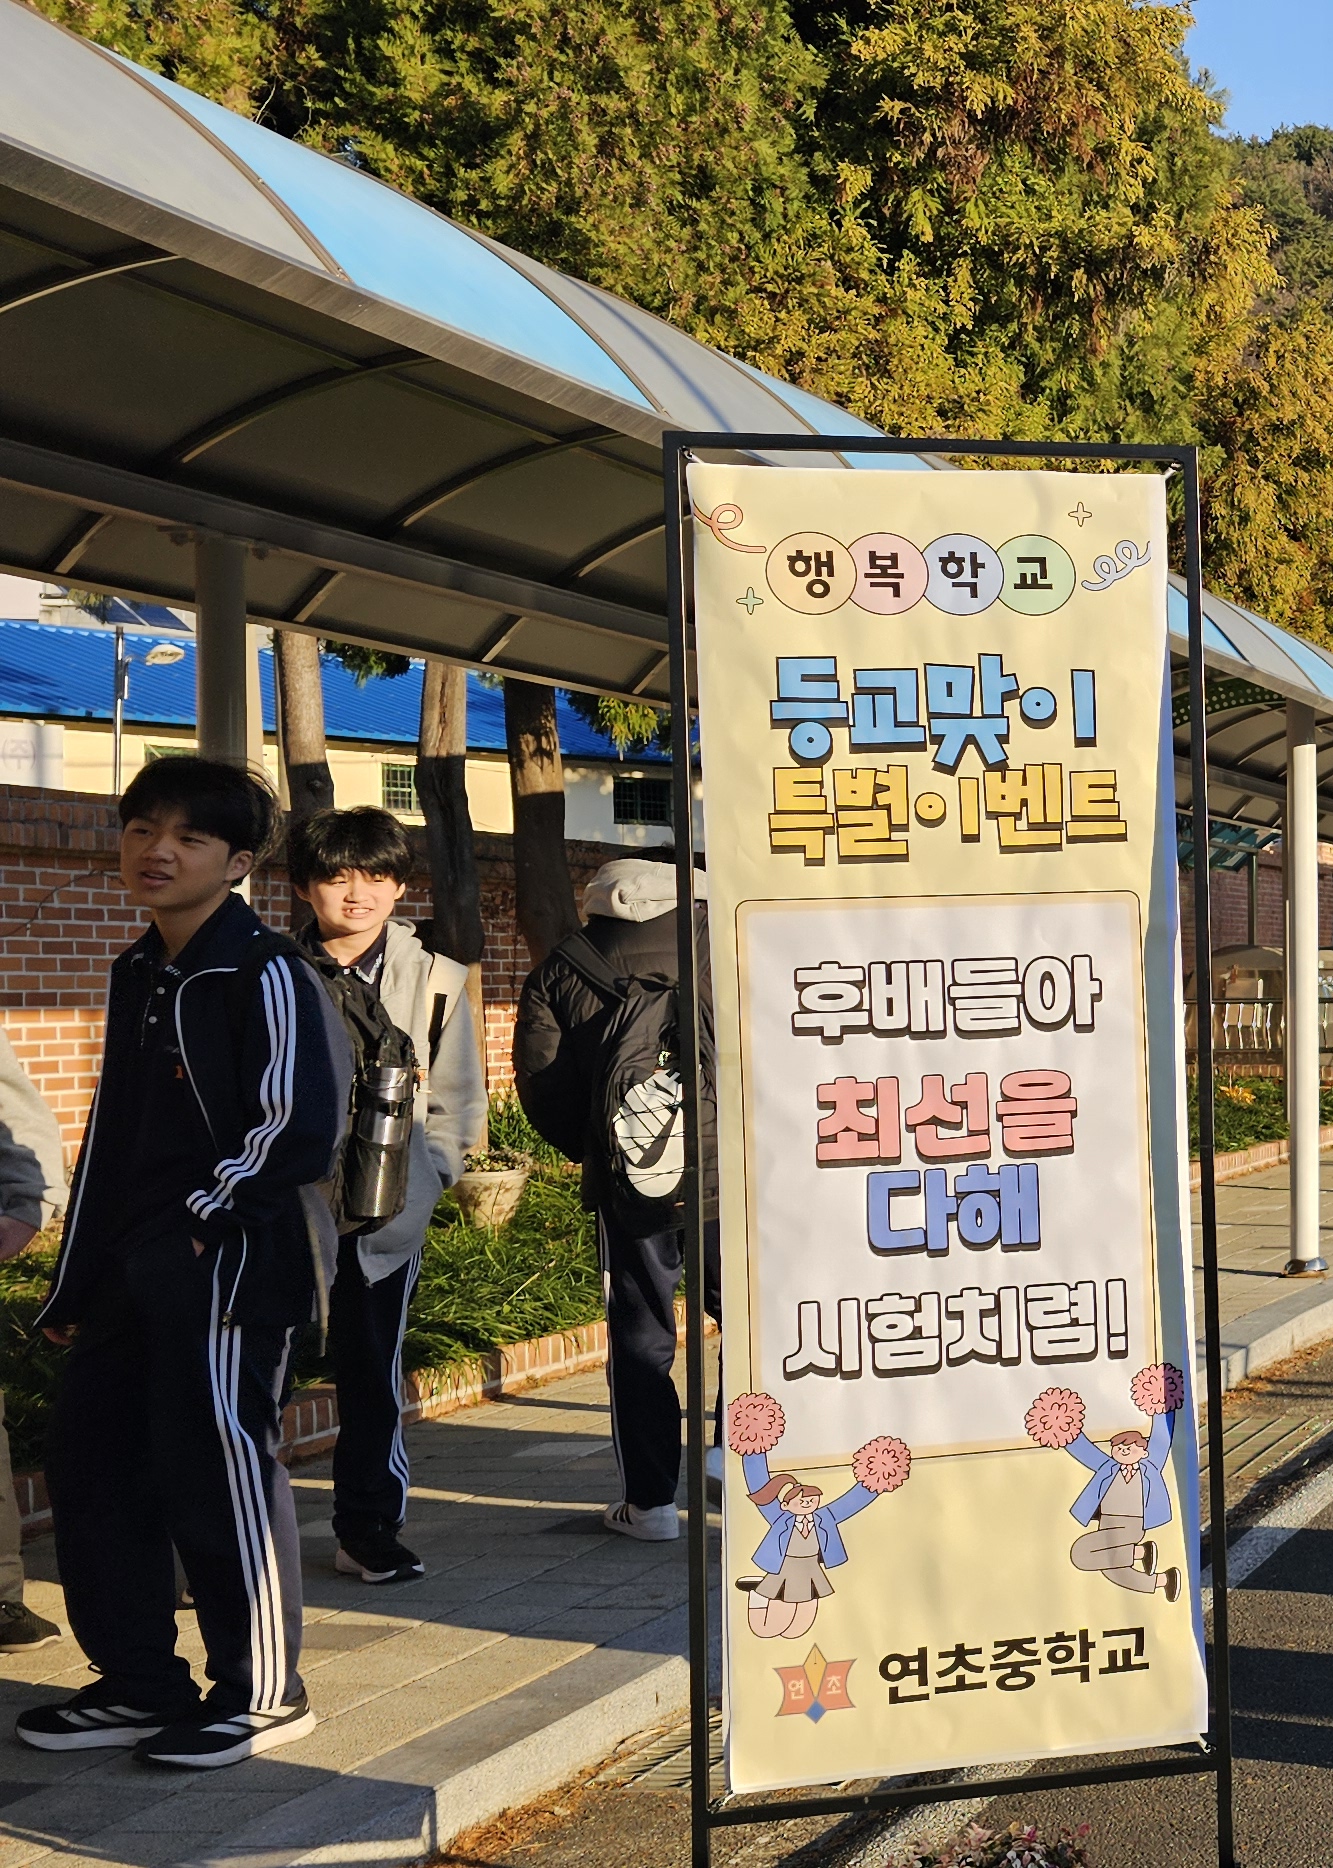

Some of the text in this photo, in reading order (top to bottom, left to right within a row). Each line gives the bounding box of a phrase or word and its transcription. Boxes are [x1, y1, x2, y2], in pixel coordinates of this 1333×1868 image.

[786, 549, 1054, 599] 행복학교
[769, 653, 1097, 774] 등교맞이
[768, 763, 1128, 866] 특별이벤트
[791, 955, 1103, 1044] 후배들아
[816, 1069, 1078, 1168] 최선을
[867, 1163, 1042, 1257] 다해
[782, 1278, 1130, 1381] 시험치렴!
[788, 1675, 842, 1701] 연 초
[878, 1626, 1150, 1705] 연초중학교
